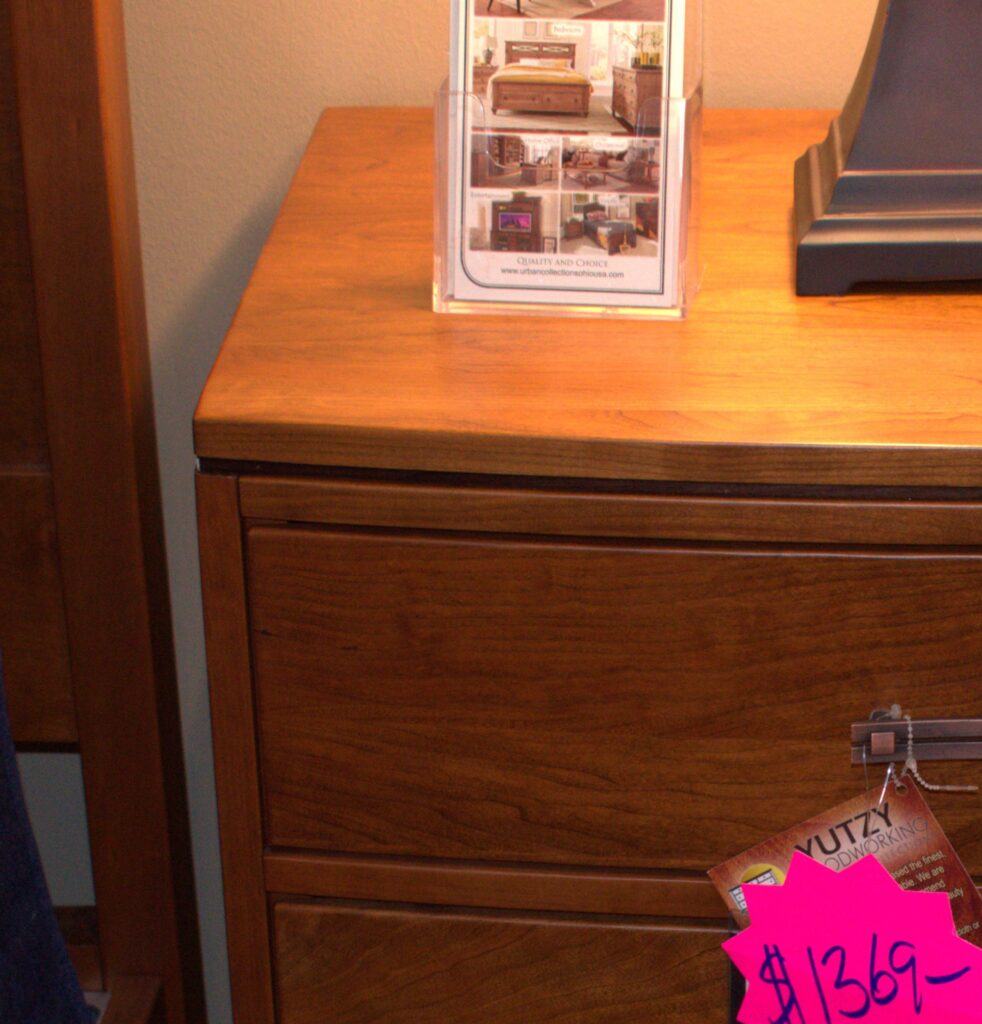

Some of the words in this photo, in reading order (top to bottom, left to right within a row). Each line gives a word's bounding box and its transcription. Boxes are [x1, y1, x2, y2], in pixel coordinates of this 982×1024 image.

[516, 256, 552, 266] QUALITY
[555, 259, 573, 267] AND
[576, 259, 608, 268] CHOICE
[794, 802, 893, 858] YUTZY
[824, 817, 929, 871] ODWORKING
